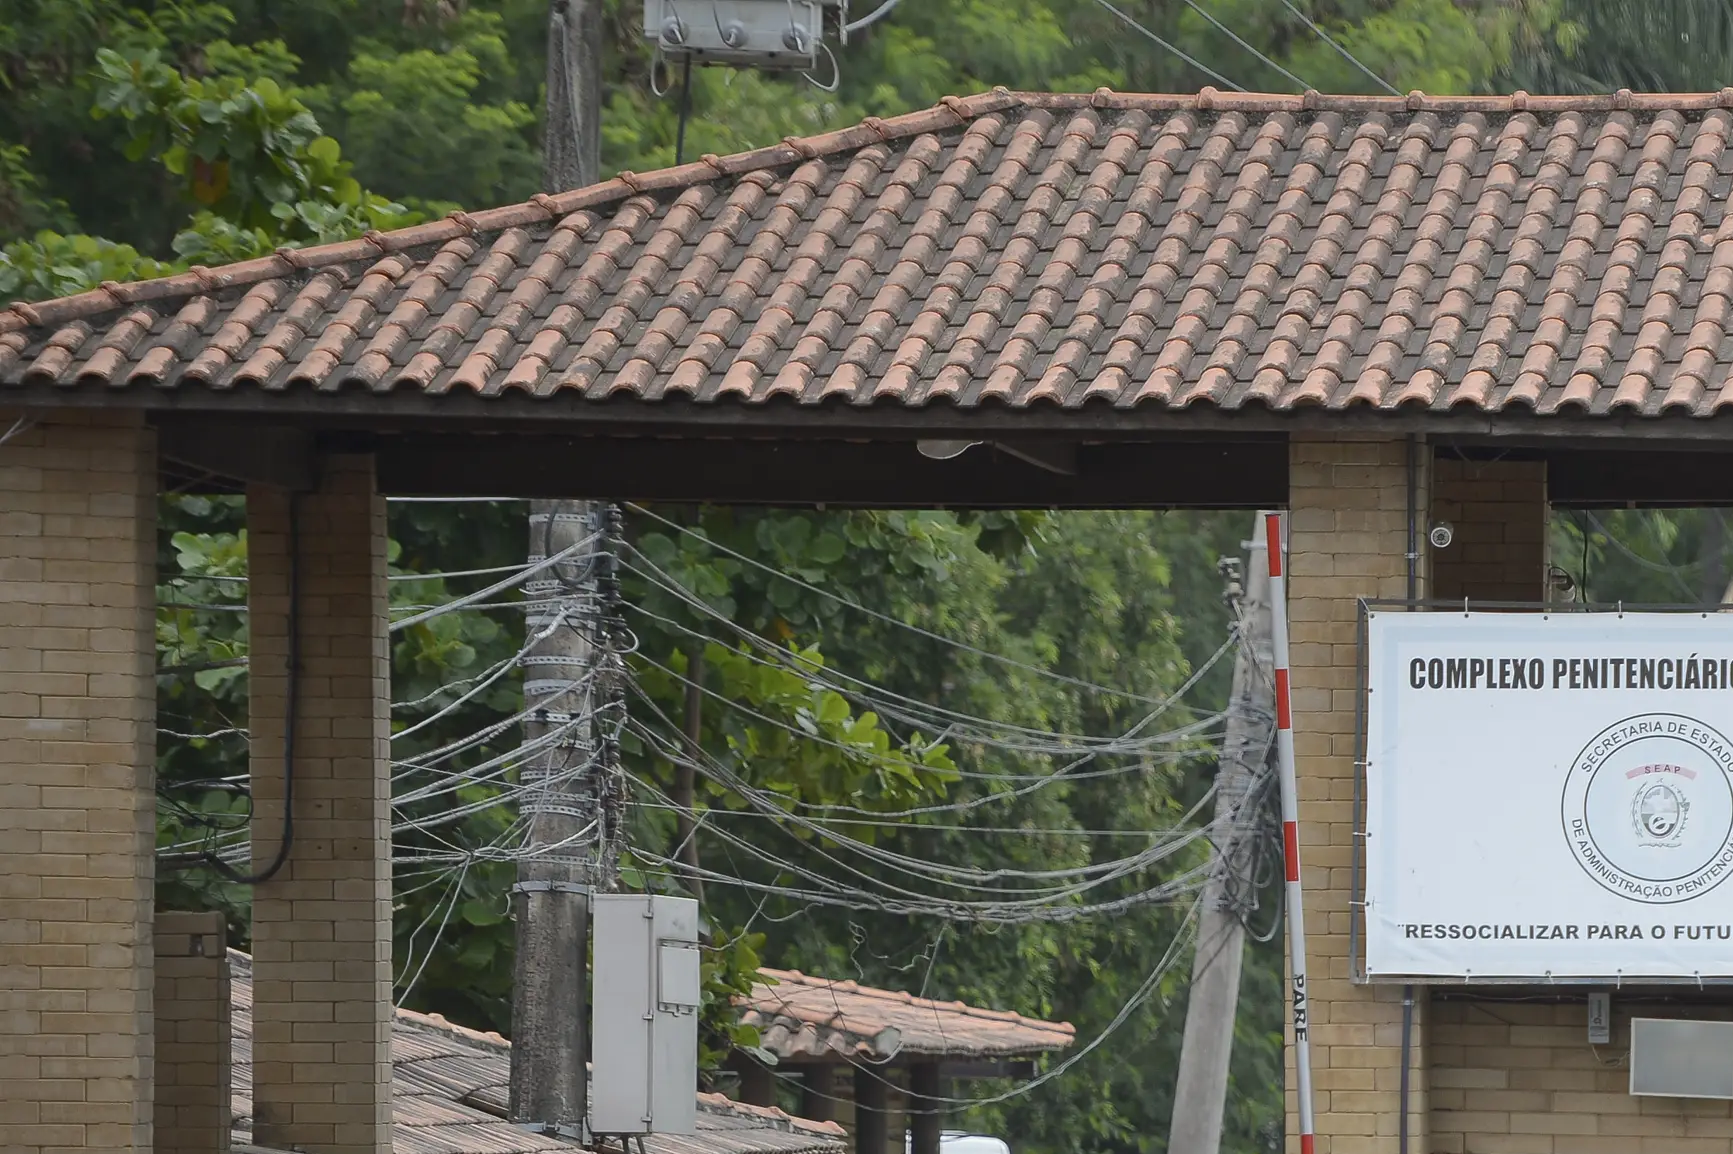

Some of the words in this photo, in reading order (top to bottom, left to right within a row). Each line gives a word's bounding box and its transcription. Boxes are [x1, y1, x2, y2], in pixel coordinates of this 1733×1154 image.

[1409, 657, 1545, 689] COMPLEXO
[1581, 721, 1663, 773] SECRETARIA
[1667, 721, 1688, 735] DE
[1644, 764, 1681, 775] SEAP
[1572, 818, 1584, 838] DE
[1577, 839, 1673, 899] ADMINISTRAÇÃO
[1587, 925, 1644, 940] PARA
[1651, 925, 1666, 940] O
[1293, 973, 1308, 1042] PARE
